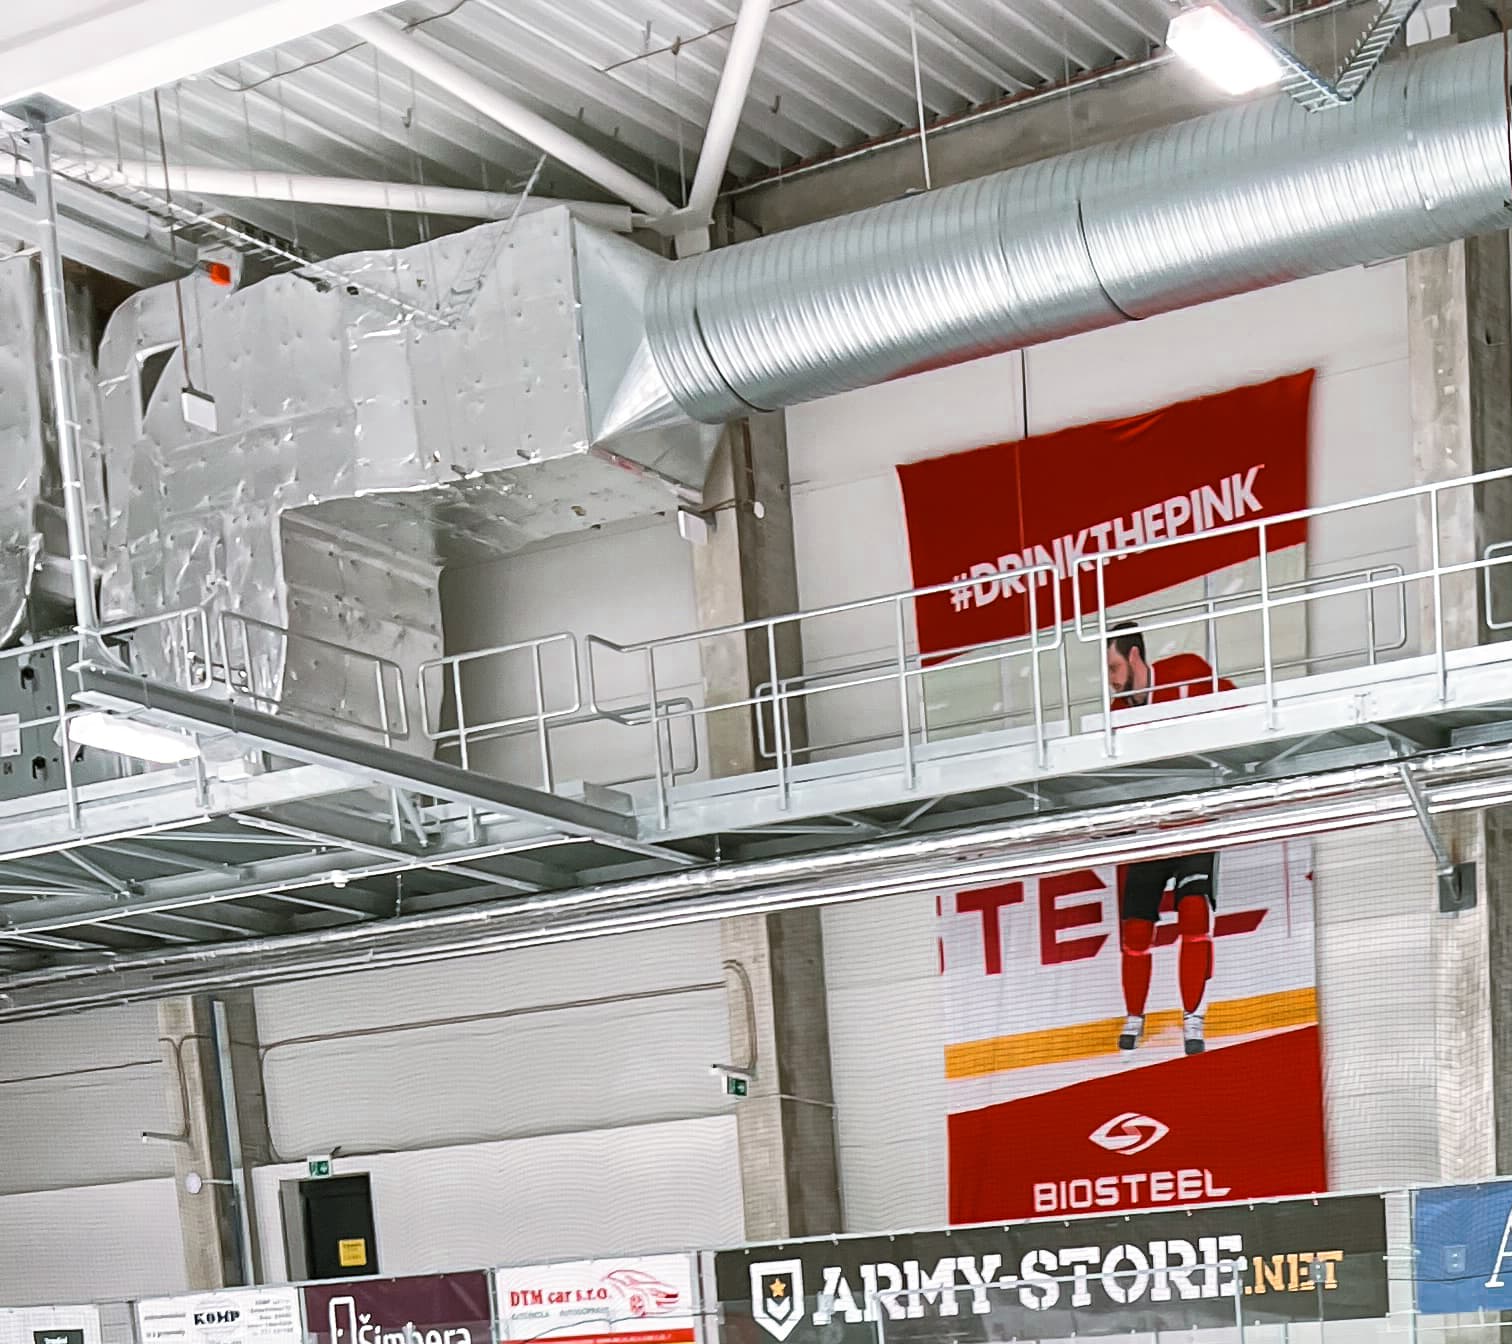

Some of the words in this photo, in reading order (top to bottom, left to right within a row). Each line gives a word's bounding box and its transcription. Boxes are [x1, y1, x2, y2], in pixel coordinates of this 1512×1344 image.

[950, 464, 1265, 611] #DRINKTHEPINK
[1034, 1168, 1231, 1212] BIOSTEEL
[510, 1289, 543, 1307] DTM
[548, 1291, 571, 1304] car
